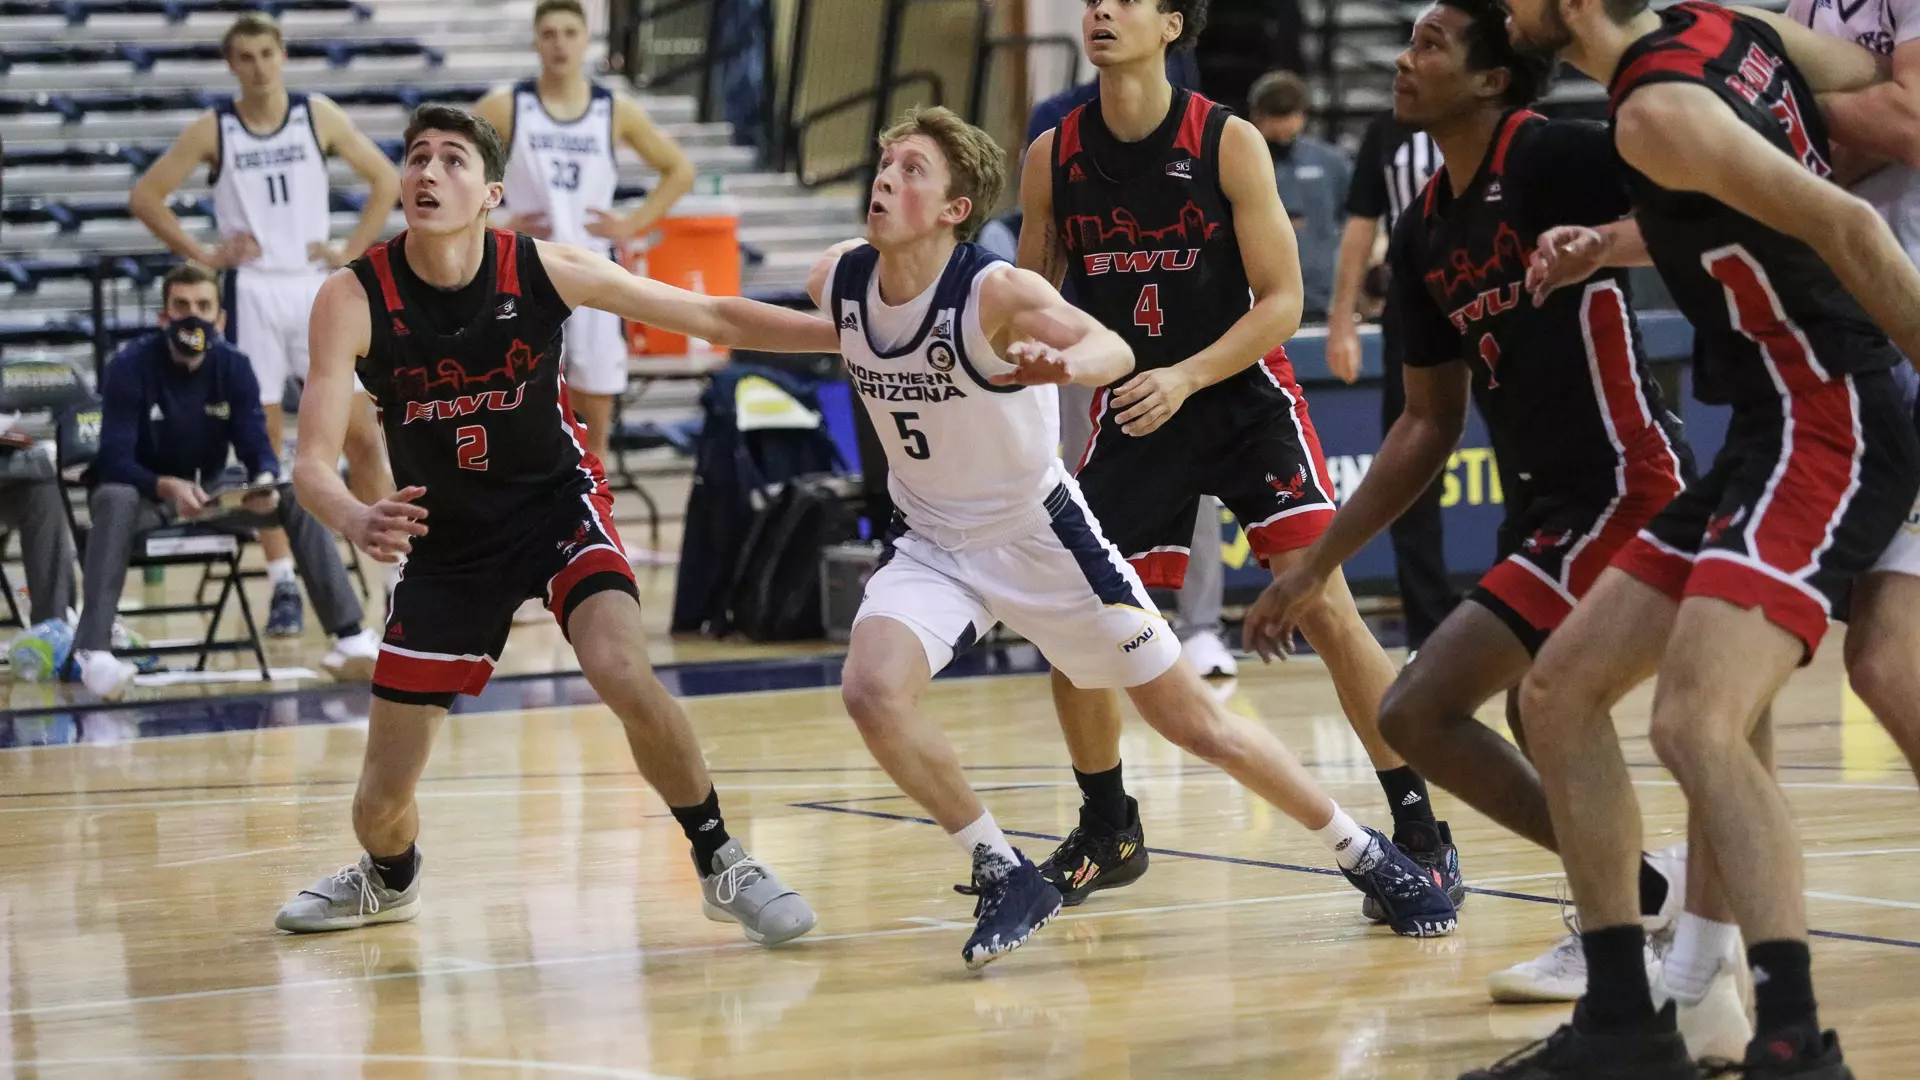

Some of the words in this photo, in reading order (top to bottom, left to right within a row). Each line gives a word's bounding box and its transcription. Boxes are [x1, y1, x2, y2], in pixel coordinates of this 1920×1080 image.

[266, 173, 289, 204] 11
[1083, 248, 1201, 276] EWU
[1133, 283, 1164, 337] 4
[847, 358, 954, 386] NORTHERN
[403, 381, 527, 425] EWU
[456, 424, 489, 472] 2
[889, 411, 931, 461] 5
[1123, 626, 1154, 653] NAU
